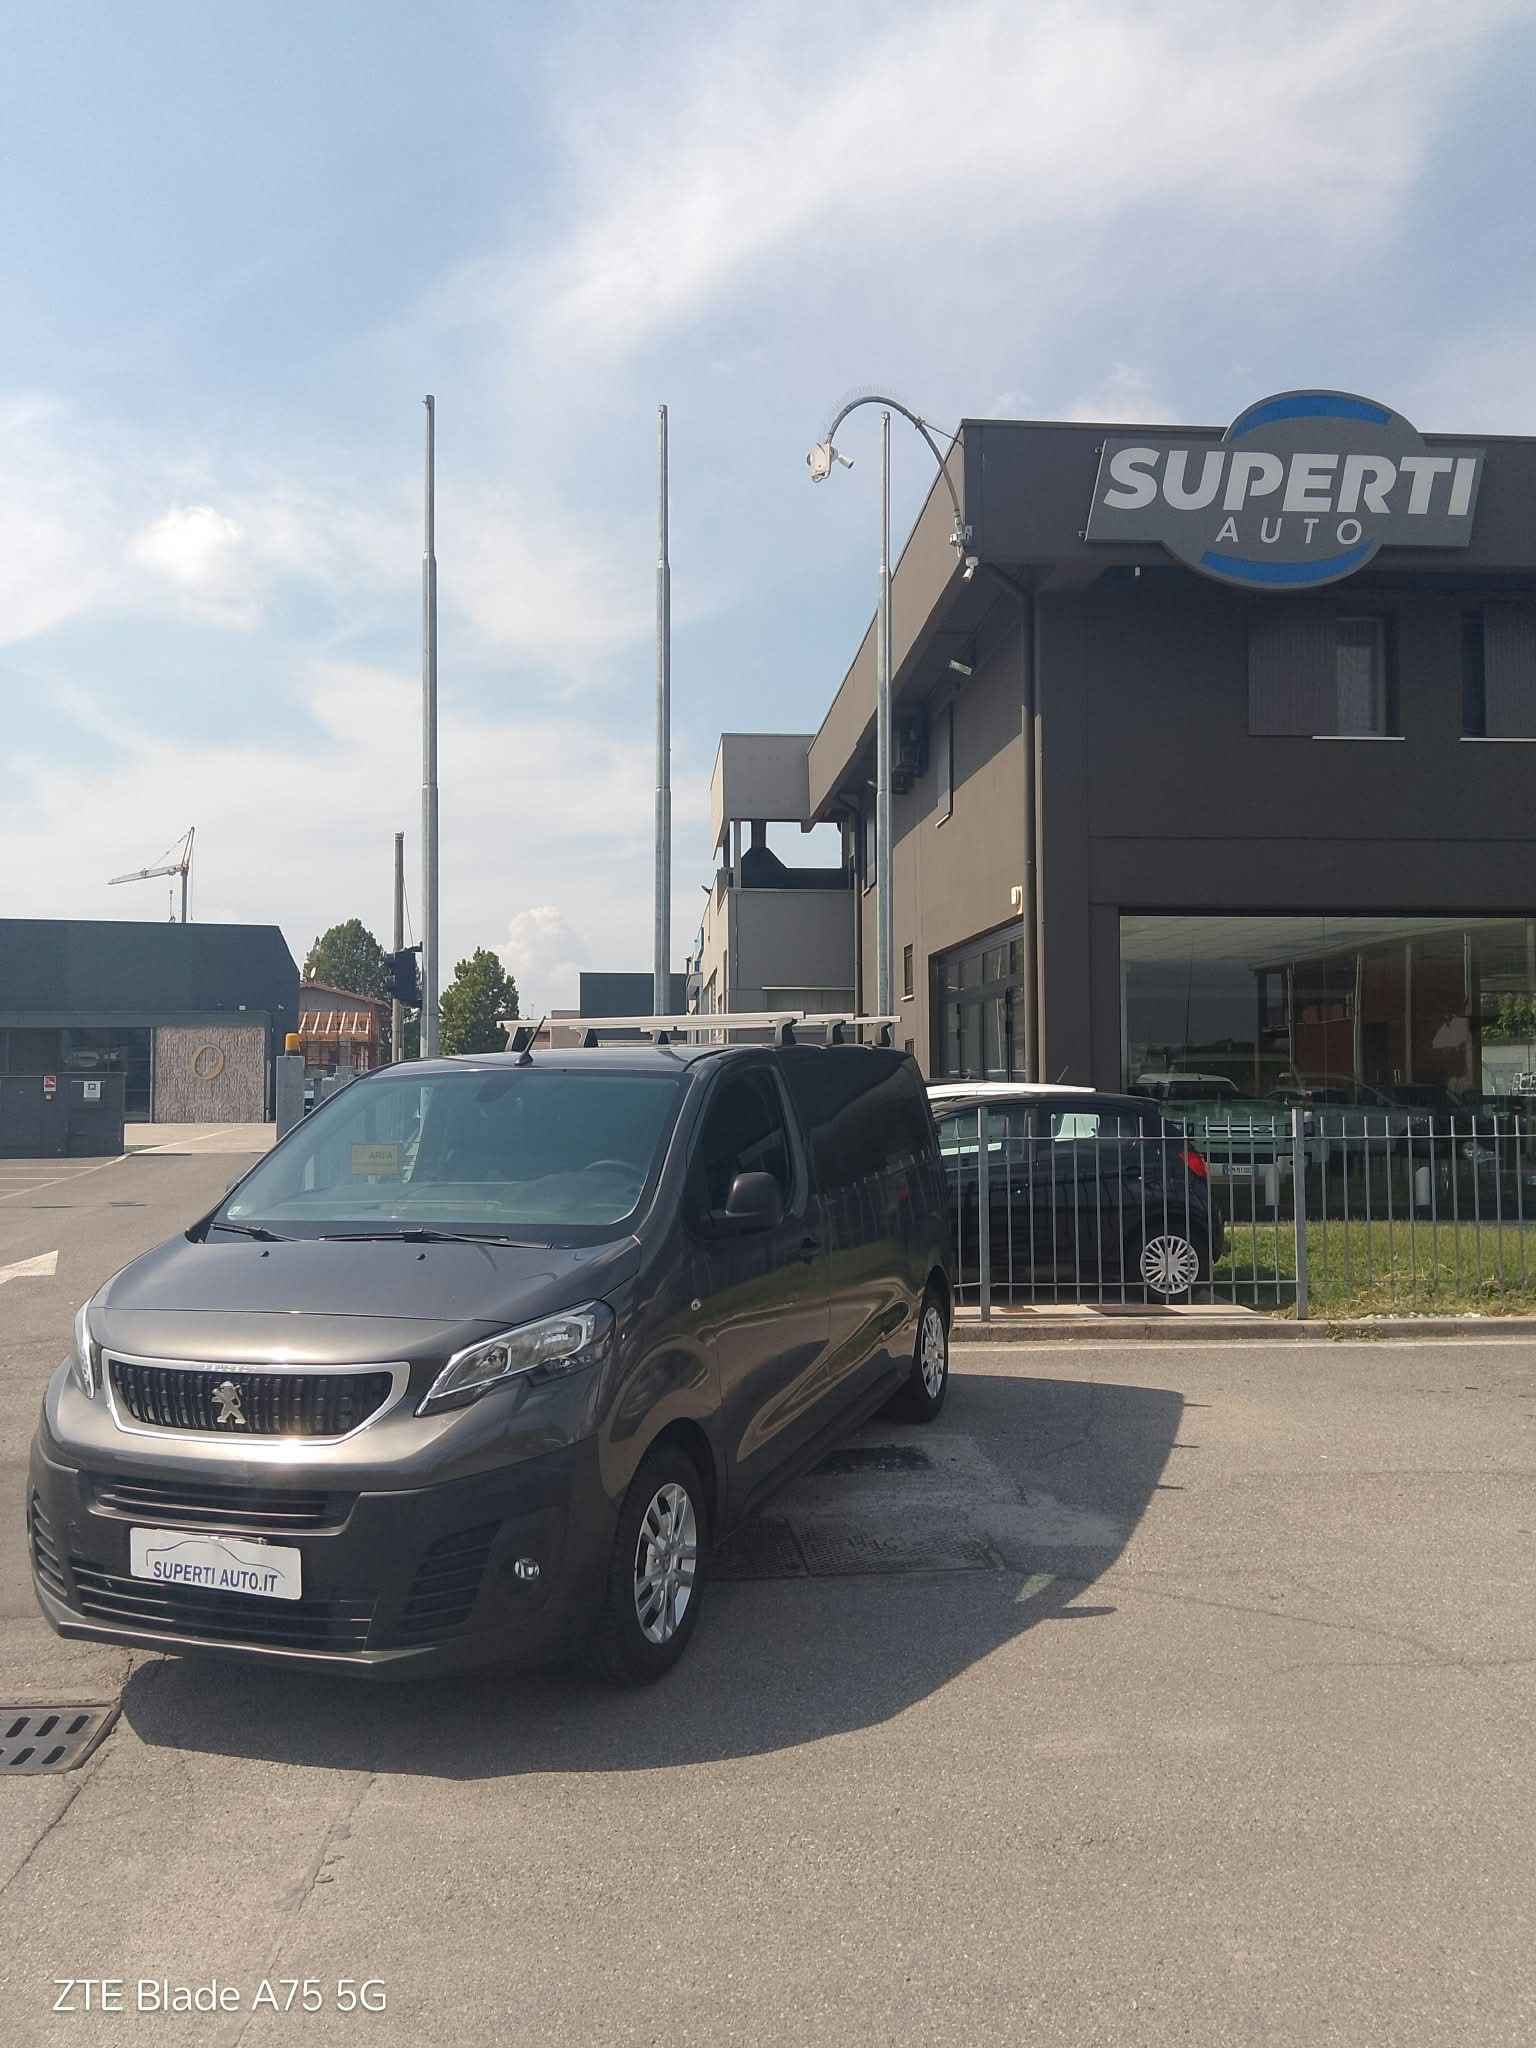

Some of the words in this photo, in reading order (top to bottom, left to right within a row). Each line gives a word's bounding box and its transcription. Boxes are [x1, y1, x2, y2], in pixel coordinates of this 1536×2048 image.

[1103, 447, 1477, 516] SUPERTI
[1215, 517, 1363, 545] AUTO
[153, 1560, 216, 1585] SUPERTI
[219, 1568, 278, 1593] AUTO.IT
